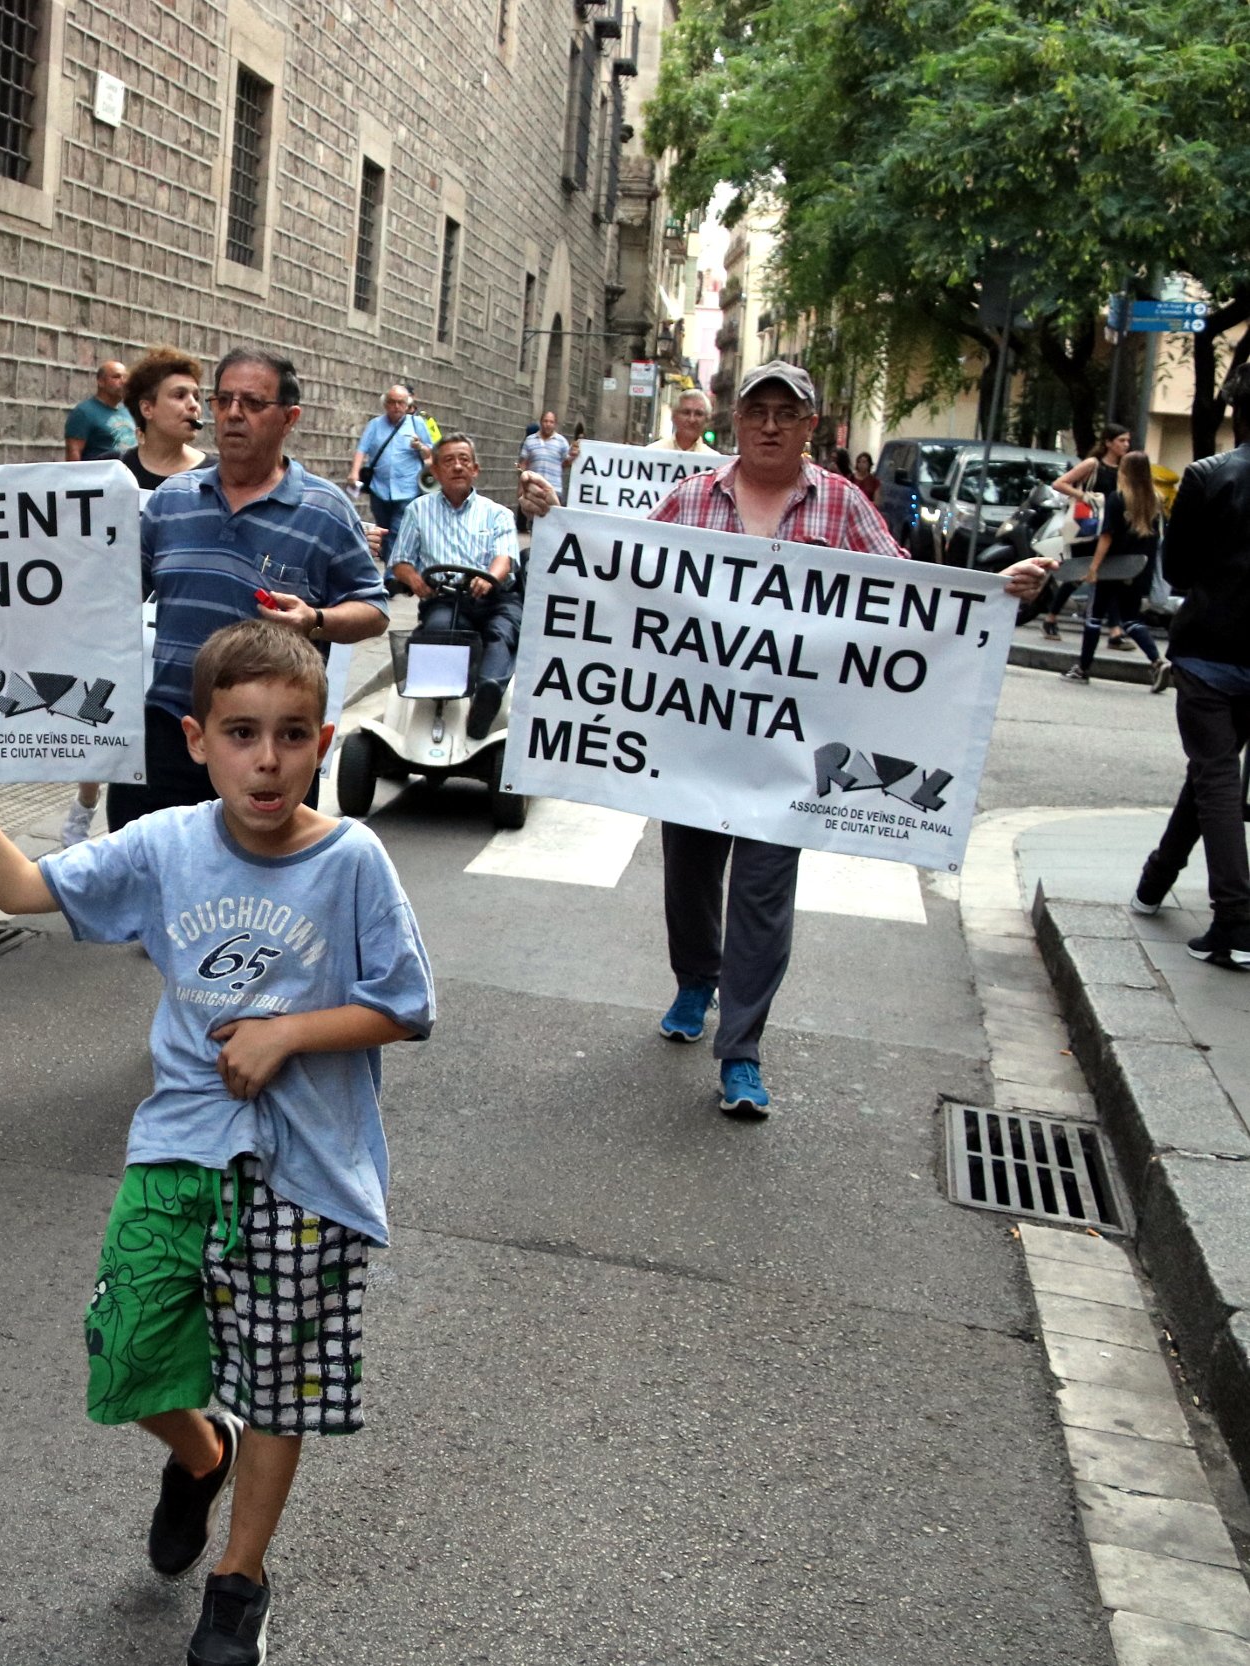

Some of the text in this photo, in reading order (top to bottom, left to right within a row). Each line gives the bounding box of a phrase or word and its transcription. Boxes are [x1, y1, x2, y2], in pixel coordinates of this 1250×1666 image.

[580, 456, 714, 484] AJUNTA
[579, 484, 608, 506] EL
[548, 533, 988, 647] AJUNTAMENT,
[544, 595, 927, 692] EL RAVAL NO
[533, 658, 804, 741] AGUANTA
[10, 748, 48, 759] CIUTAT
[51, 748, 86, 759] VELLA
[19, 733, 32, 745] DE
[36, 732, 68, 745] VEÏNS
[71, 734, 91, 746] DEL
[94, 735, 129, 747] RAVAL
[529, 714, 659, 778] MÉS.
[789, 800, 953, 837] ASSOCIACIÓ DE VEÏNS DEL RAVAL
[825, 818, 909, 840] DE CIUTAT VELLA
[197, 931, 282, 991] 65
[176, 986, 293, 1013] AMERICA OOTBALL
